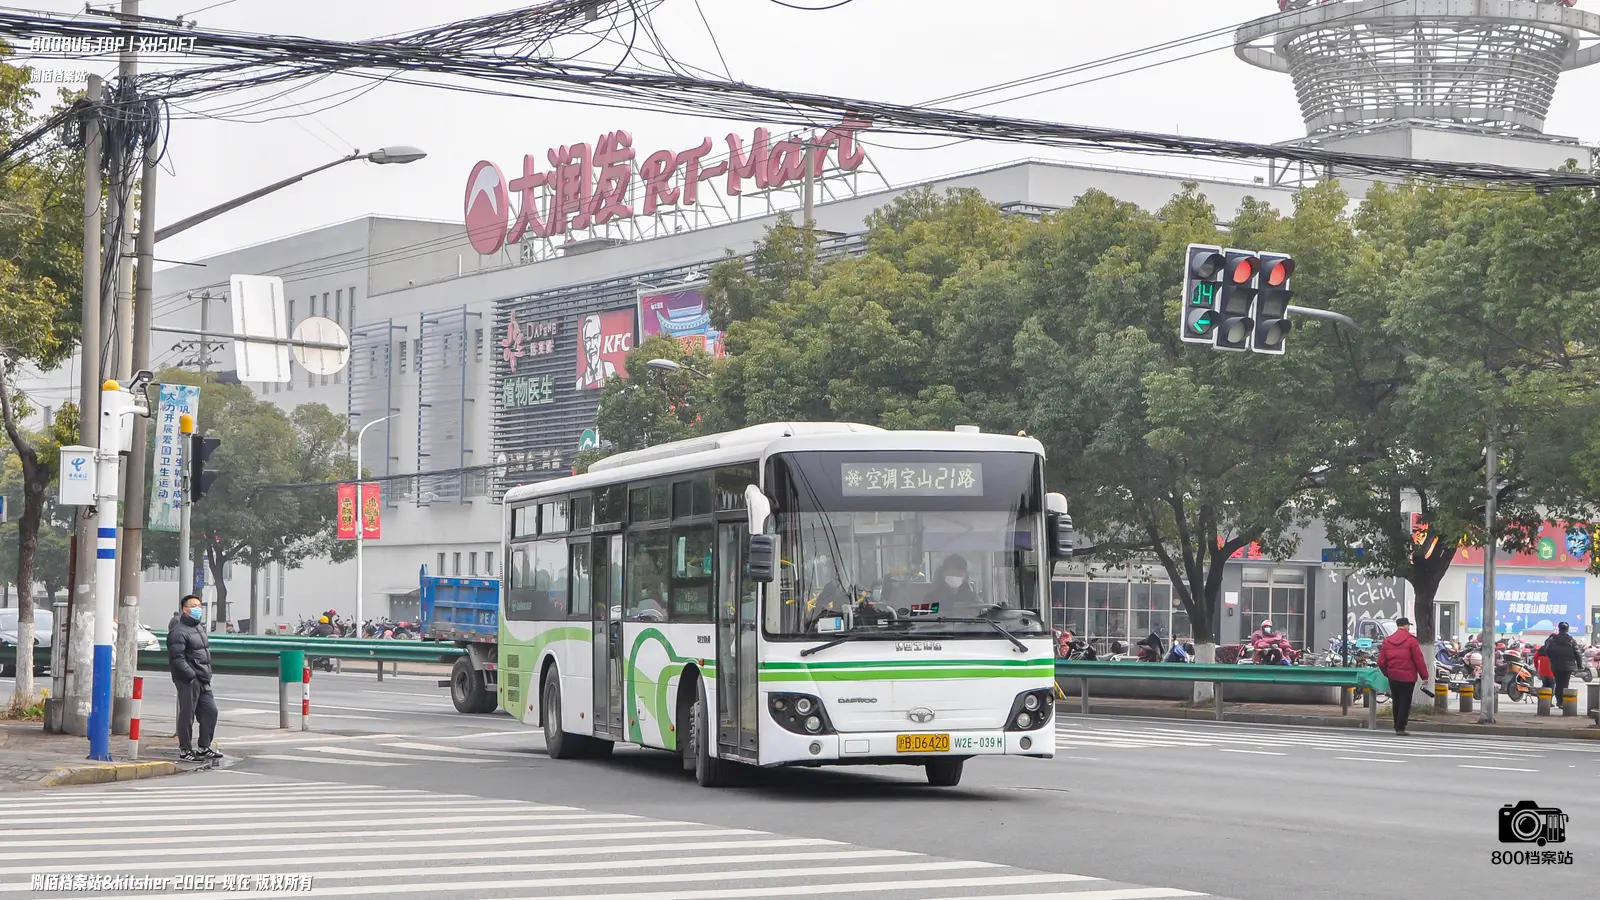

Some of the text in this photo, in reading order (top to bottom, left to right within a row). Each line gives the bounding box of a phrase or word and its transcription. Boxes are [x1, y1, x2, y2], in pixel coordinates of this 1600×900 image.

[507, 129, 636, 244] 大润发
[640, 109, 873, 216] RT-Mart
[602, 332, 631, 354] KFC
[502, 375, 554, 409] 植物医生
[157, 392, 177, 499] 大力开展爱国卫生运动
[866, 467, 976, 489] 空调宝山21路
